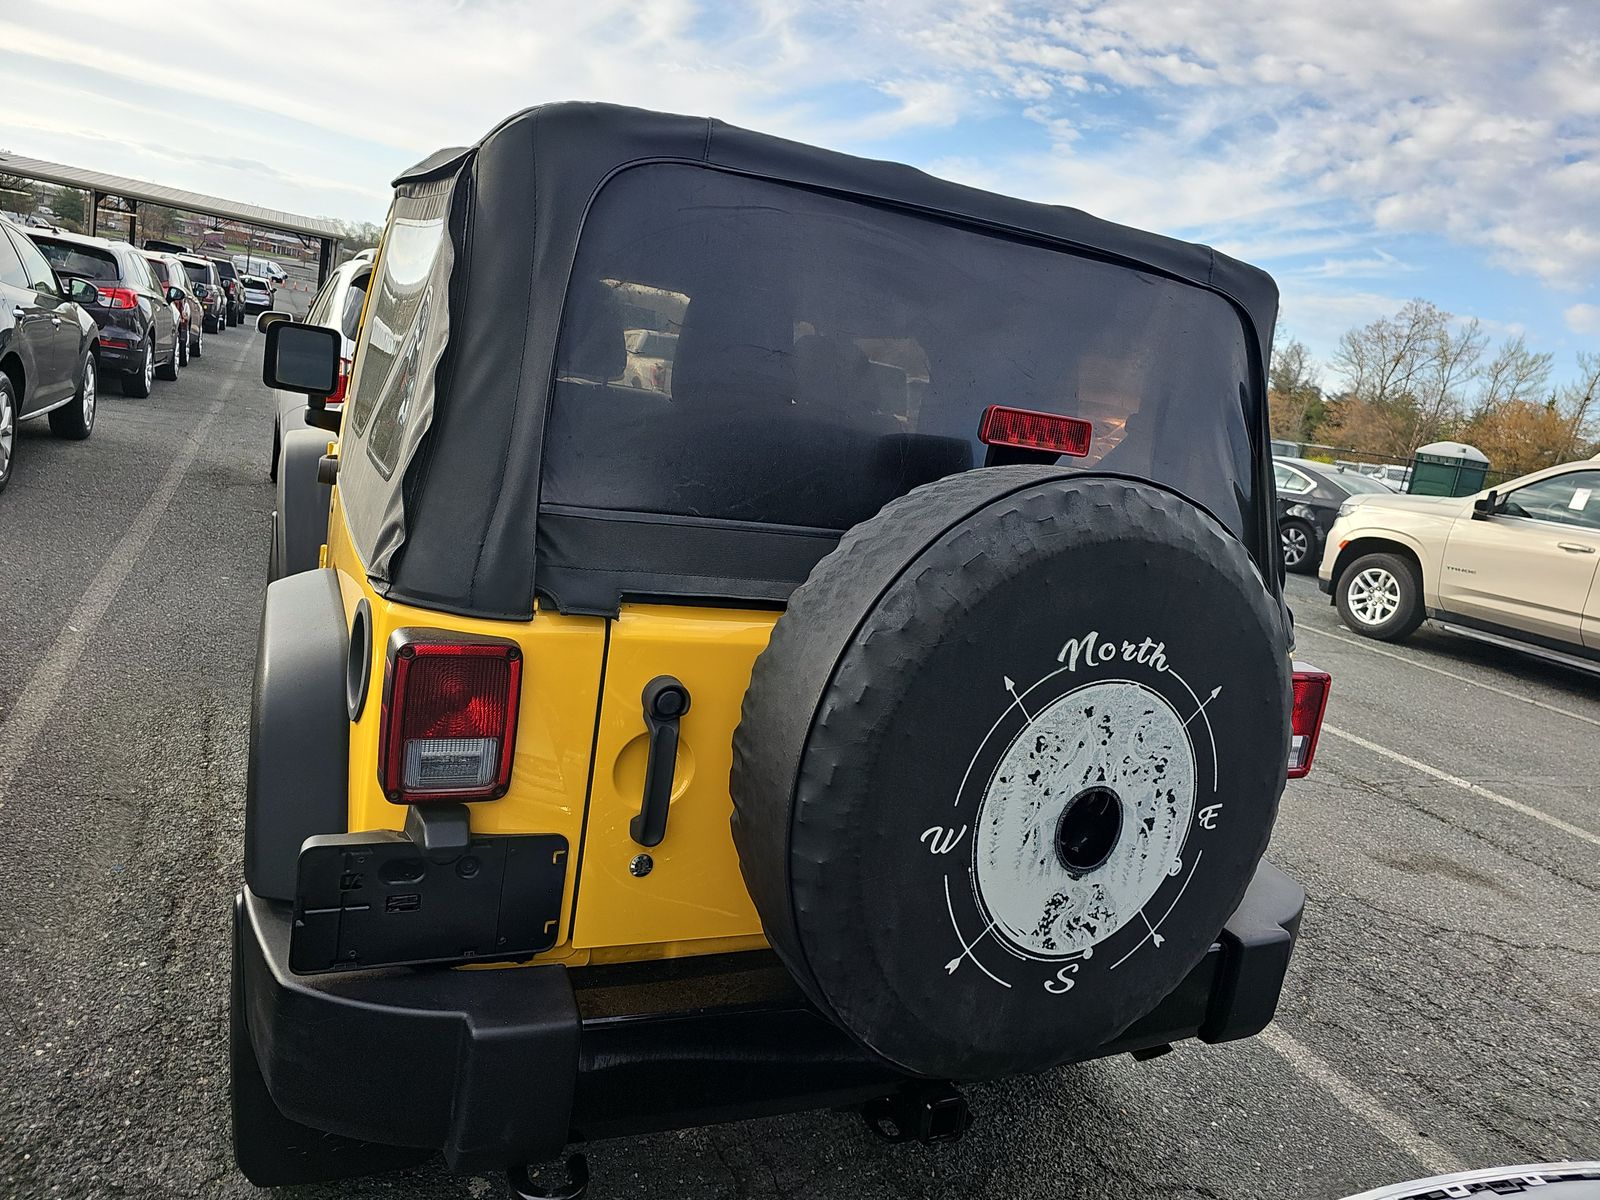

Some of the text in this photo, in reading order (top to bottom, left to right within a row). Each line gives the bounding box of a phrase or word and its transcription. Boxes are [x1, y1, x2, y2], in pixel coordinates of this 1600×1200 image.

[1057, 631, 1170, 672] North
[1198, 802, 1223, 831] E
[920, 825, 967, 855] W
[1043, 963, 1080, 994] S
